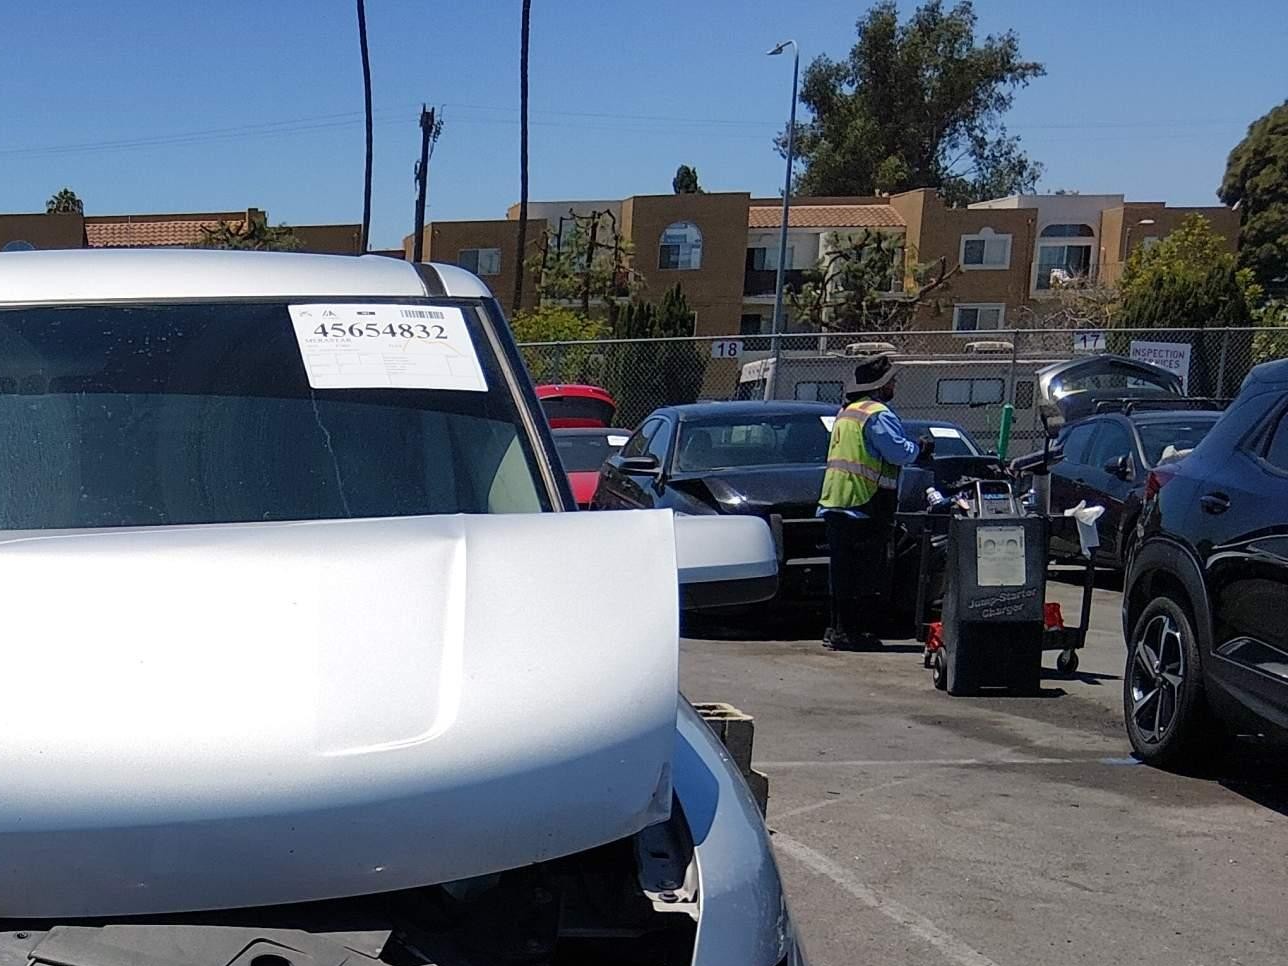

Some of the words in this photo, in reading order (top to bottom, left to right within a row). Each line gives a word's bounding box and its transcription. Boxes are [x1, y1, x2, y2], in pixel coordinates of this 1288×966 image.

[314, 322, 447, 339] 45654832
[1080, 335, 1100, 348] 17
[718, 342, 737, 357] 18
[1133, 348, 1185, 360] INSPECTION
